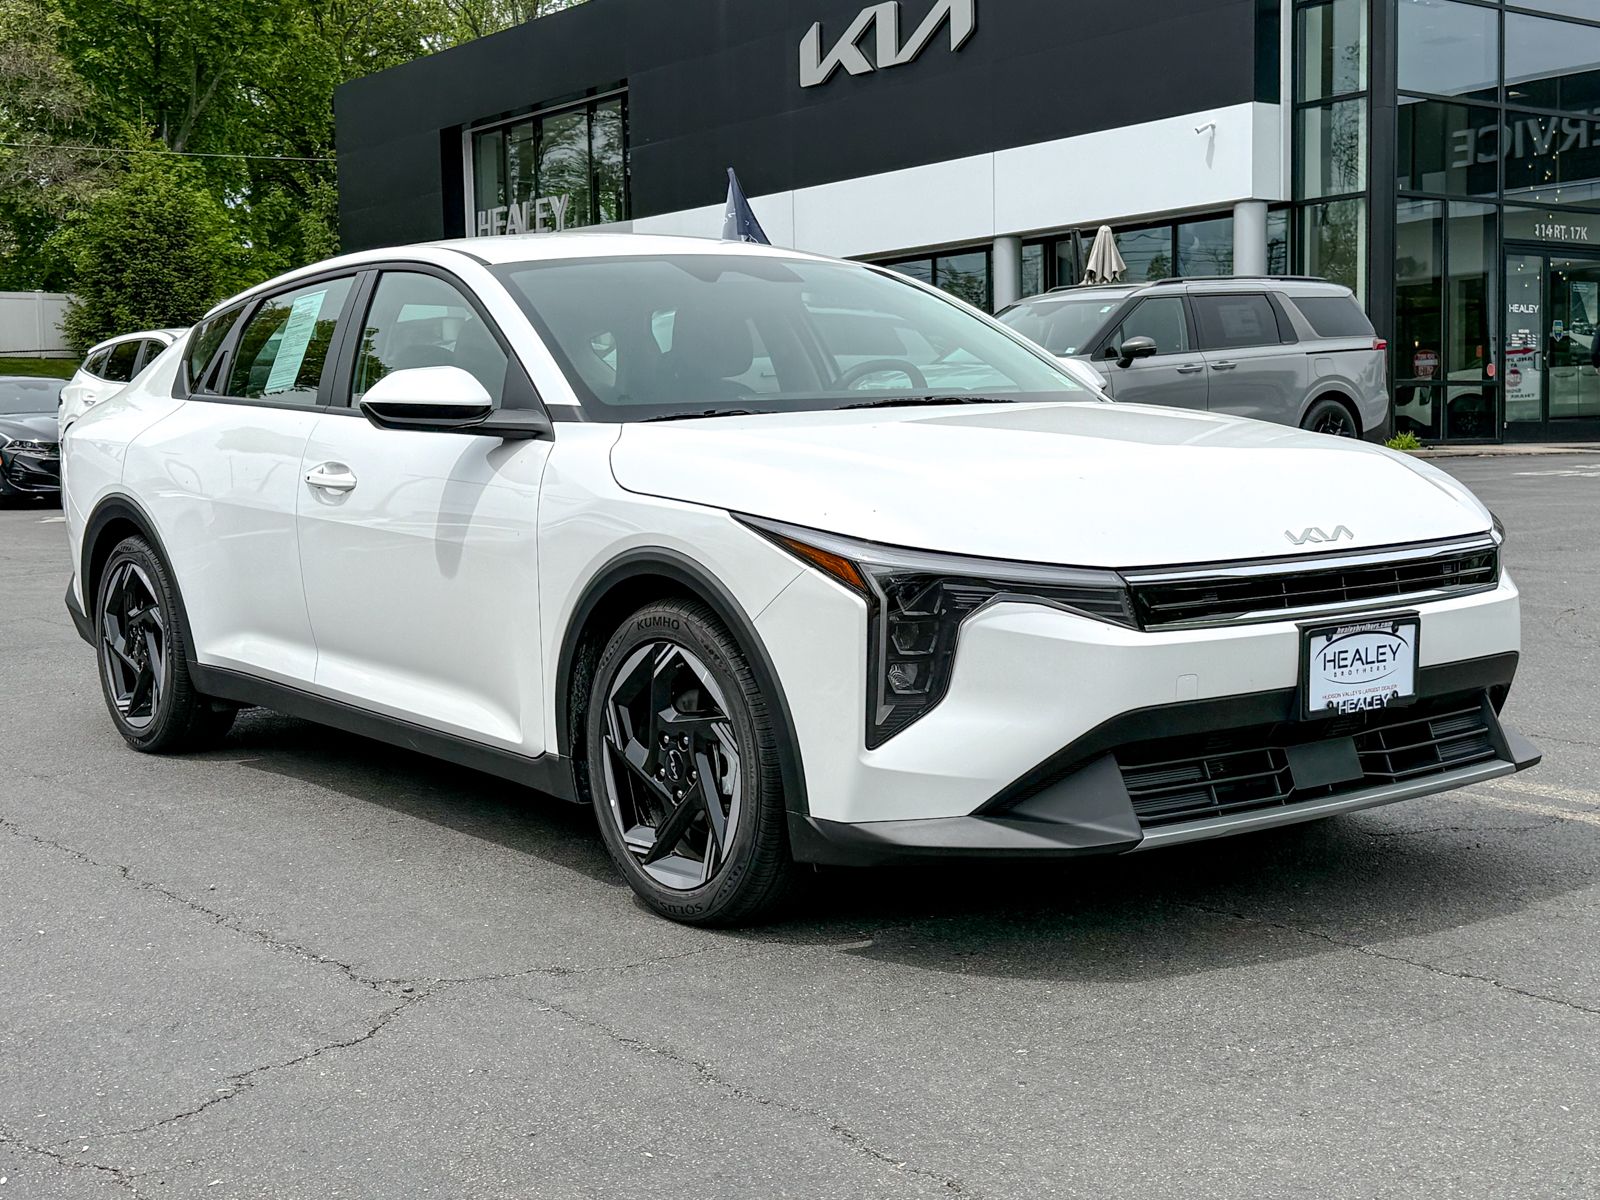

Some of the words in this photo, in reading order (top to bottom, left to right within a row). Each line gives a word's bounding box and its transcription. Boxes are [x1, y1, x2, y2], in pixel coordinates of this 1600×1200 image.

[799, 0, 976, 88] KIA
[477, 193, 569, 236] HEALEY
[1554, 224, 1568, 240] RT.
[1570, 226, 1588, 240] 17K
[1508, 303, 1539, 314] HEALEY
[1284, 524, 1354, 545] KIA
[636, 616, 680, 631] KUMHO
[1323, 642, 1401, 671] HEALEY
[1333, 665, 1386, 677] BROTHERS
[1337, 693, 1389, 715] HEALEY
